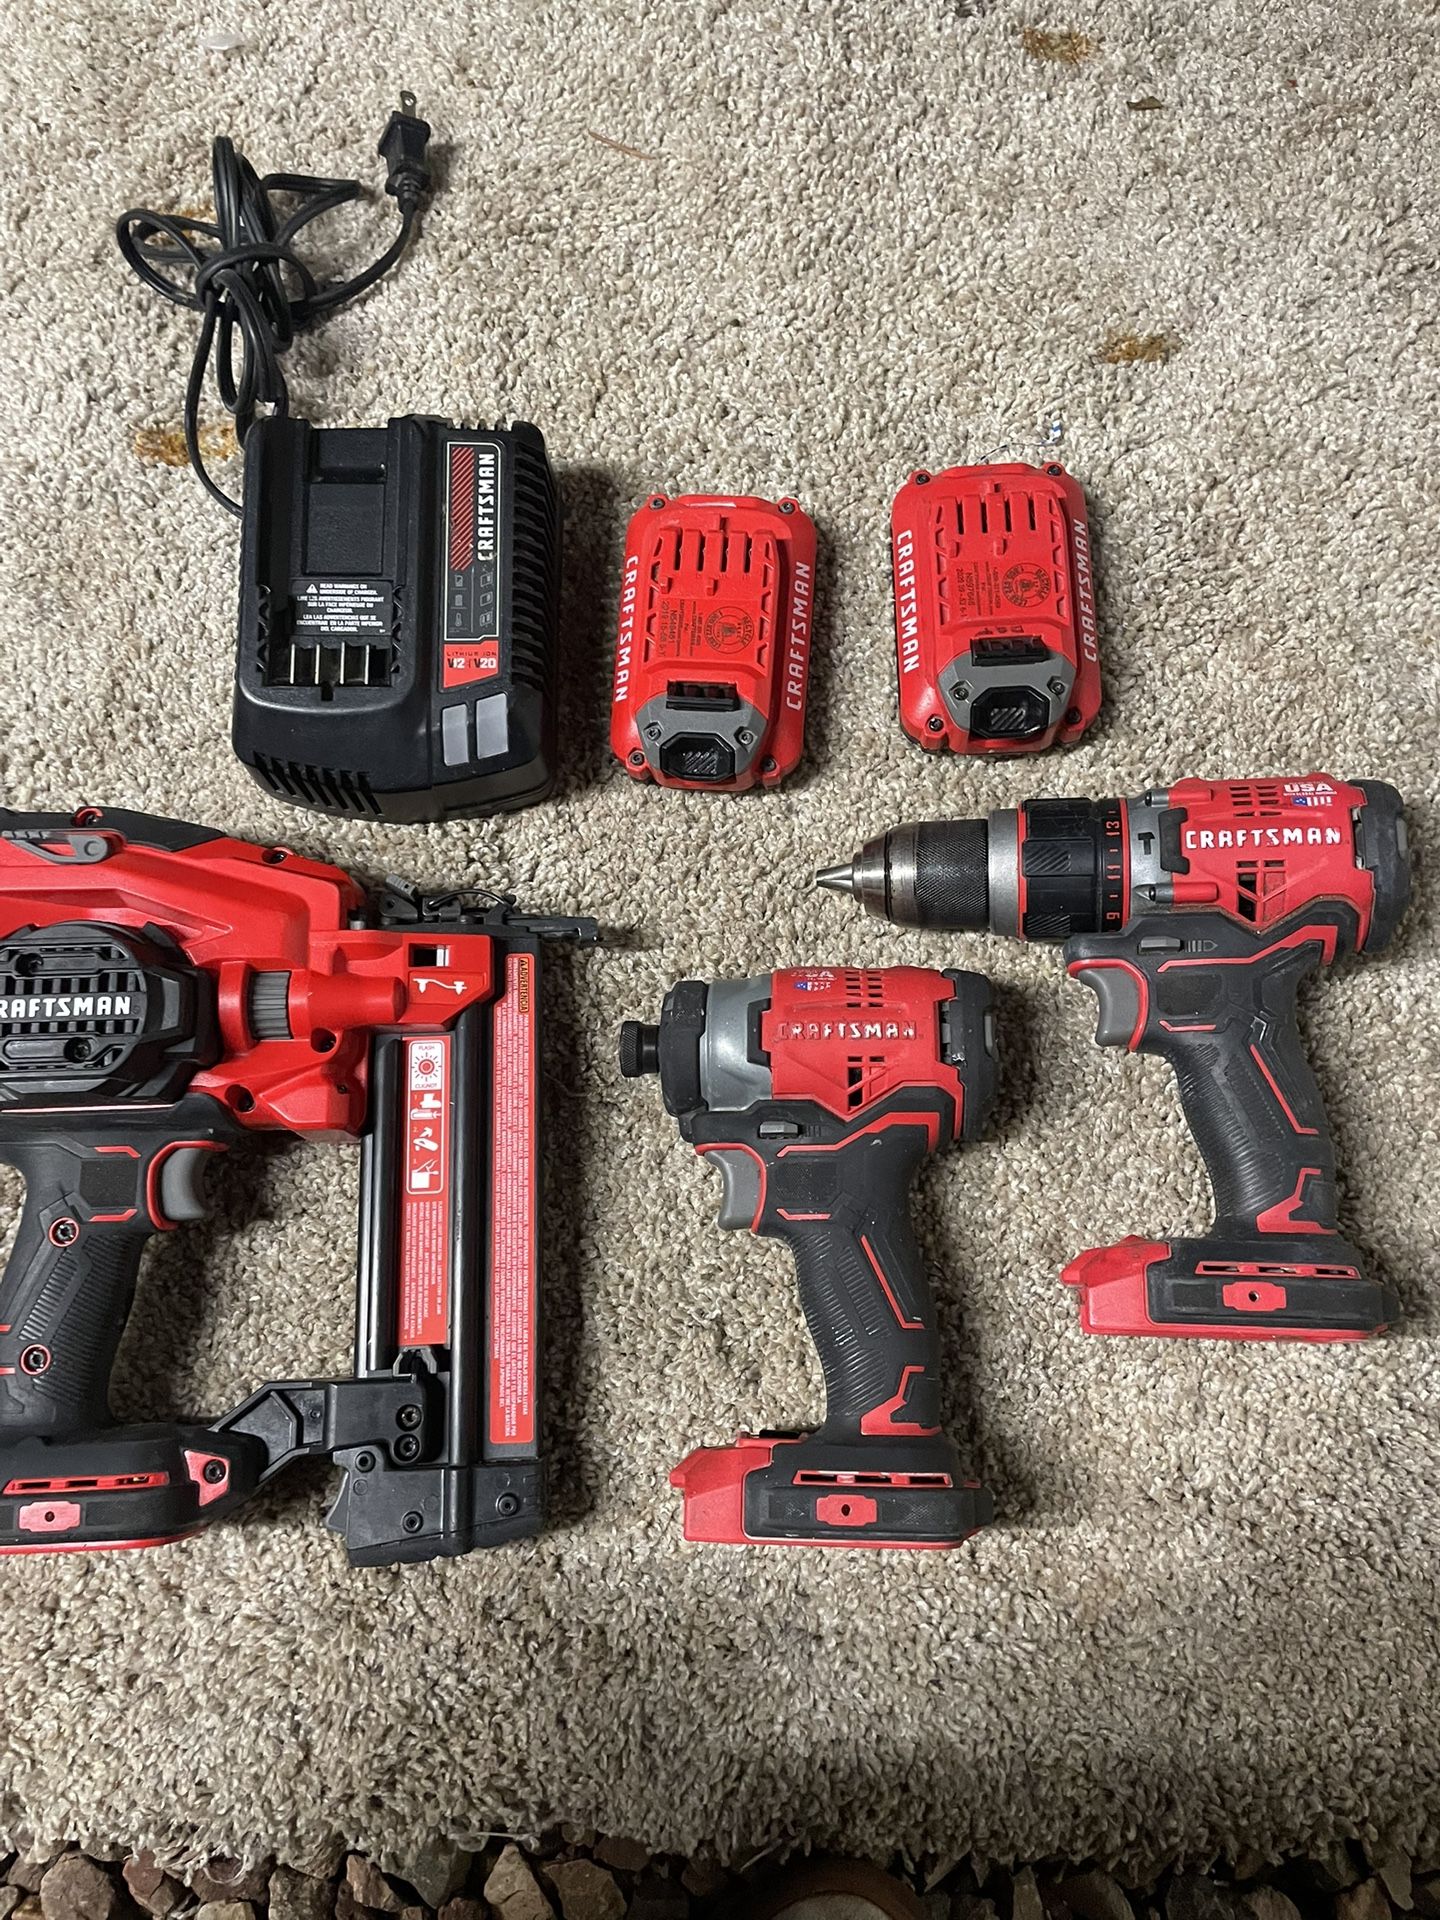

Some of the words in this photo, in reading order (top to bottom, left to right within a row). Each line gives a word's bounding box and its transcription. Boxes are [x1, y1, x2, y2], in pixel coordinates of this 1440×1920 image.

[478, 453, 495, 561] CRAFTSMAN
[898, 529, 920, 673] CRAFTSMAN
[1074, 519, 1097, 663] CRAFTSMAN
[615, 555, 639, 702] CRAFTSMAN
[787, 562, 810, 711] CRAFTSMAN
[447, 657, 465, 669] V12
[474, 657, 496, 669] V20
[1284, 783, 1333, 792] USA
[1106, 820, 1120, 836] 13
[1185, 827, 1341, 849] CRAFTSMAN
[1106, 864, 1121, 880] 11
[520, 966, 528, 1010] ADVERTENCIA
[777, 1020, 917, 1041] CRAFTSMAN
